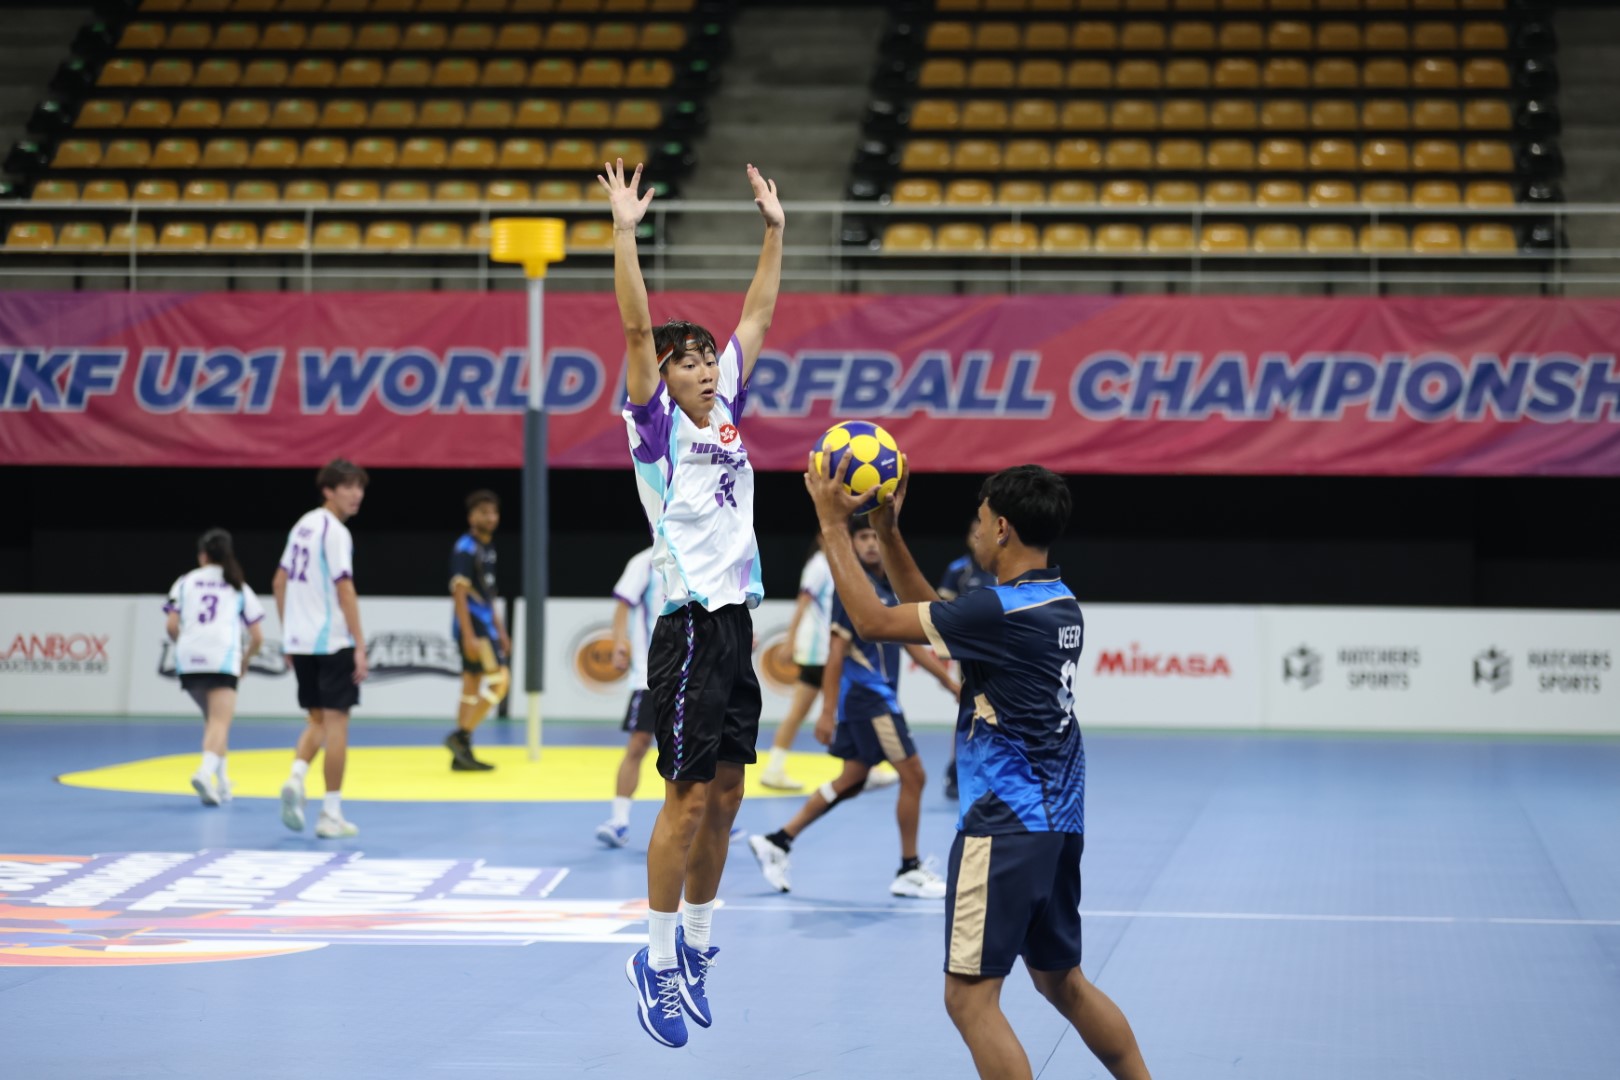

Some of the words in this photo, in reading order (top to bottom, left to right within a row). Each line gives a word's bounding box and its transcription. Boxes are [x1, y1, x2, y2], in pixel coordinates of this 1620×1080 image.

[134, 346, 284, 414] U21
[298, 347, 606, 415] WORLD
[611, 350, 1055, 420] RFBALL
[198, 594, 219, 624] 3
[1058, 625, 1081, 649] VEER
